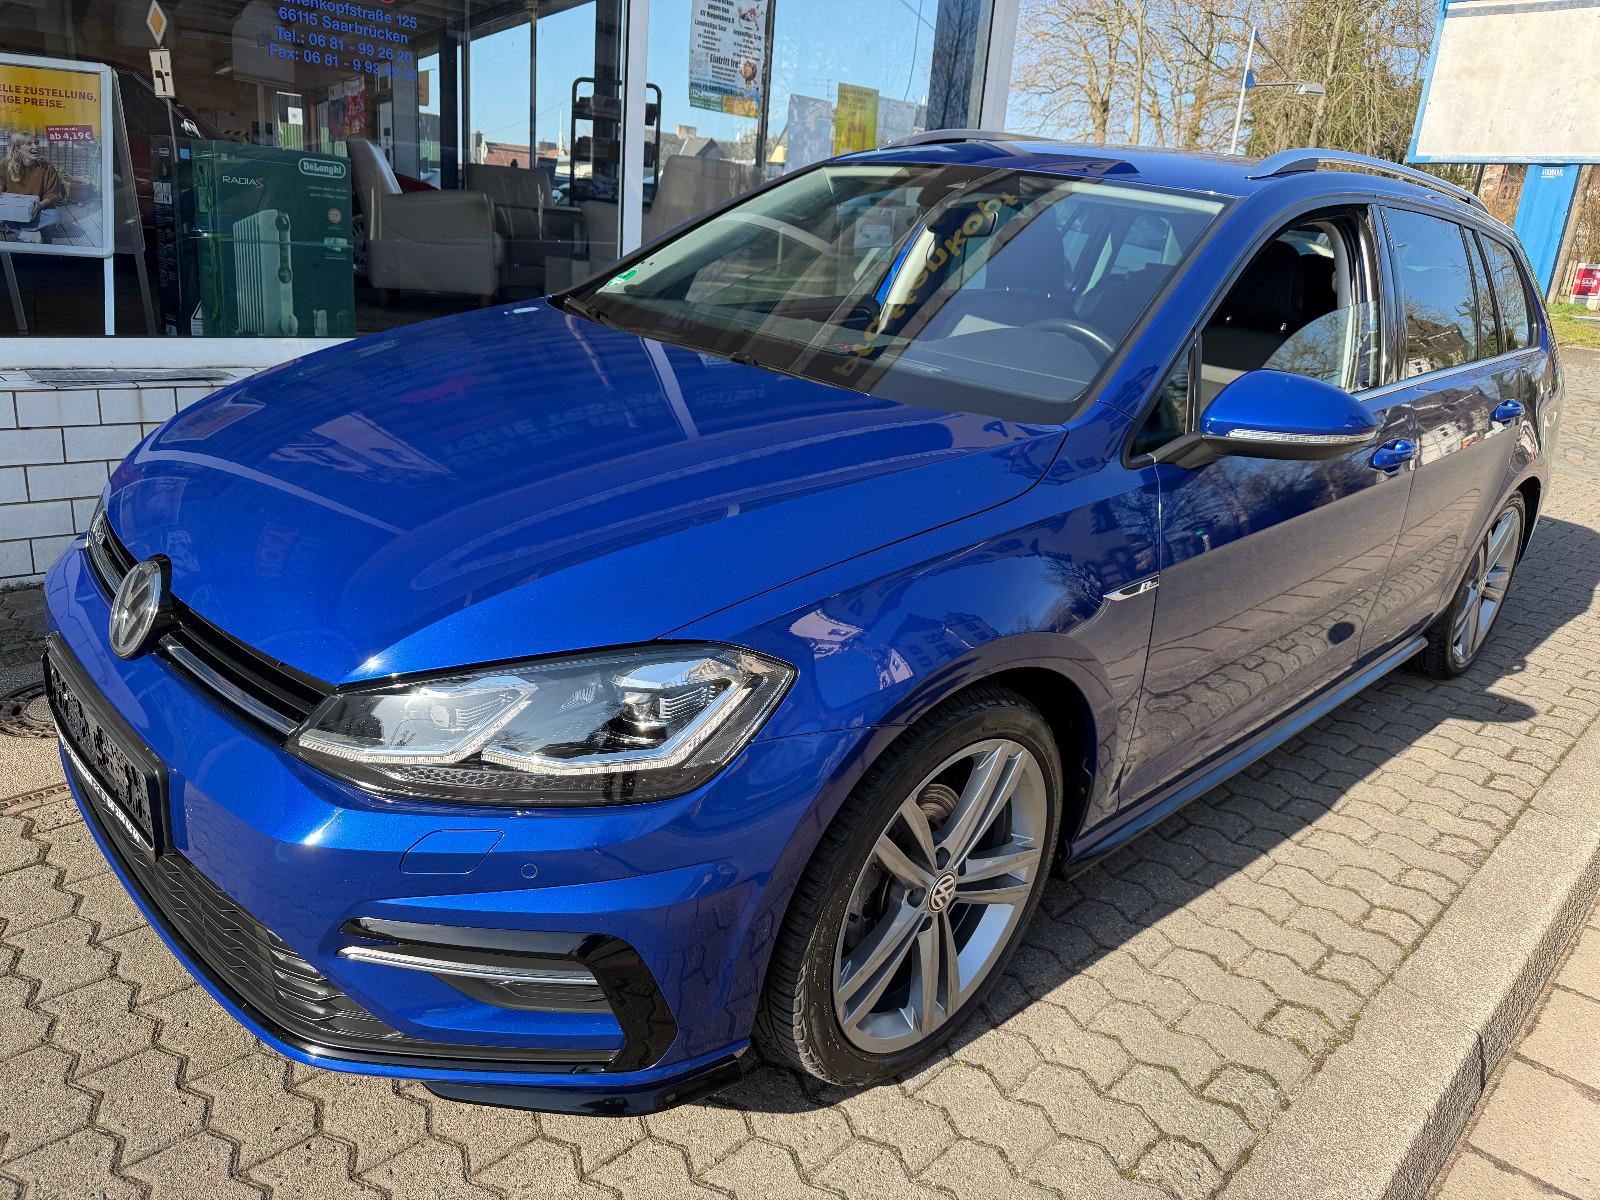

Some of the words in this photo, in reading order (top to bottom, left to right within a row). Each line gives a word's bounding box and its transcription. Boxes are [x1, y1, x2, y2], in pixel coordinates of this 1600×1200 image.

[279, 6, 318, 25] 66115
[322, 15, 408, 44] Saarbrücken
[397, 15, 417, 29] 125
[275, 26, 304, 44] Tel.:
[309, 32, 326, 47] 06
[329, 37, 344, 50] 81
[358, 42, 374, 56] 99
[378, 46, 394, 60] 26
[268, 43, 299, 60] Fax:
[303, 49, 321, 64] 06
[324, 53, 339, 67] 81
[353, 59, 361, 71] 9
[709, 53, 730, 66] Eintritt
[23, 86, 97, 102] ZUSTELLUNG,
[23, 96, 66, 109] PREISE.
[49, 131, 61, 140] ab
[63, 131, 91, 141] 4,19€
